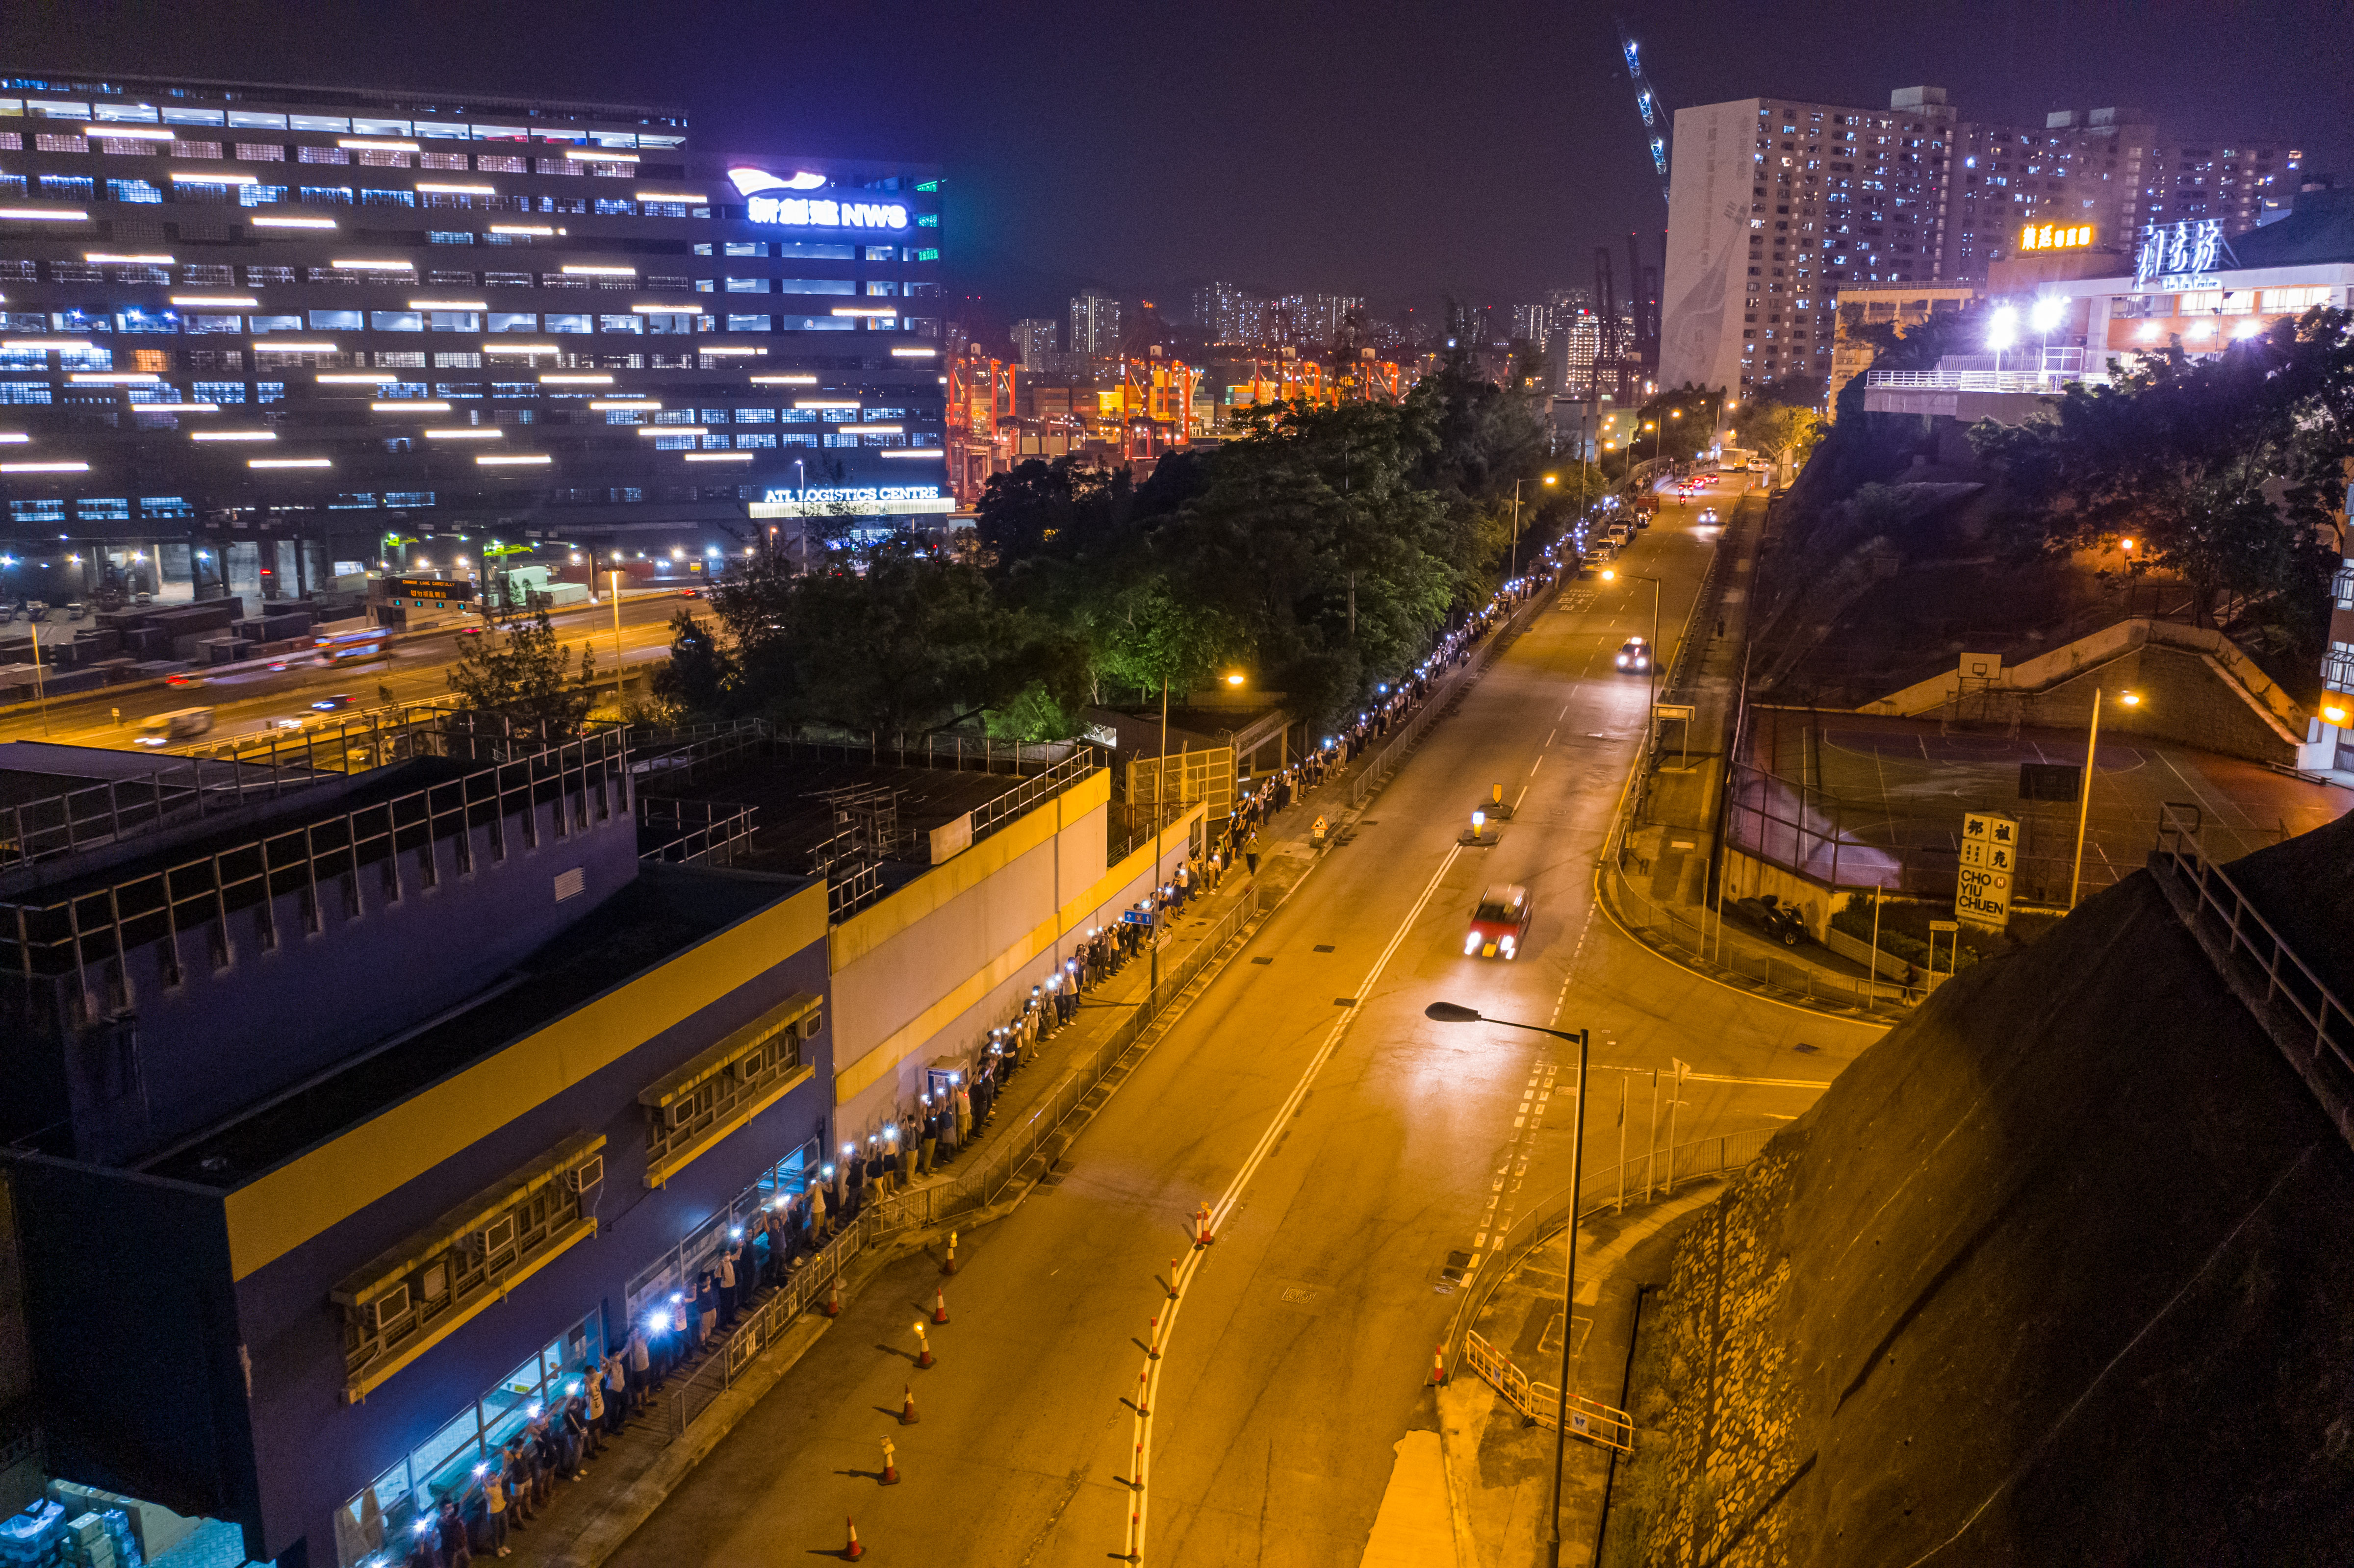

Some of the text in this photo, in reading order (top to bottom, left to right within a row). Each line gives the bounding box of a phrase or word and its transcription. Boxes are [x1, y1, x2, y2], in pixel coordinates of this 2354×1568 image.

[748, 197, 907, 228] 新創建 NWS
[764, 486, 939, 503] ATL LOGISTICS CENTRE
[1961, 869, 1992, 886] CHO
[1961, 882, 1982, 897] YIU
[1959, 895, 2004, 915] CHUEN
